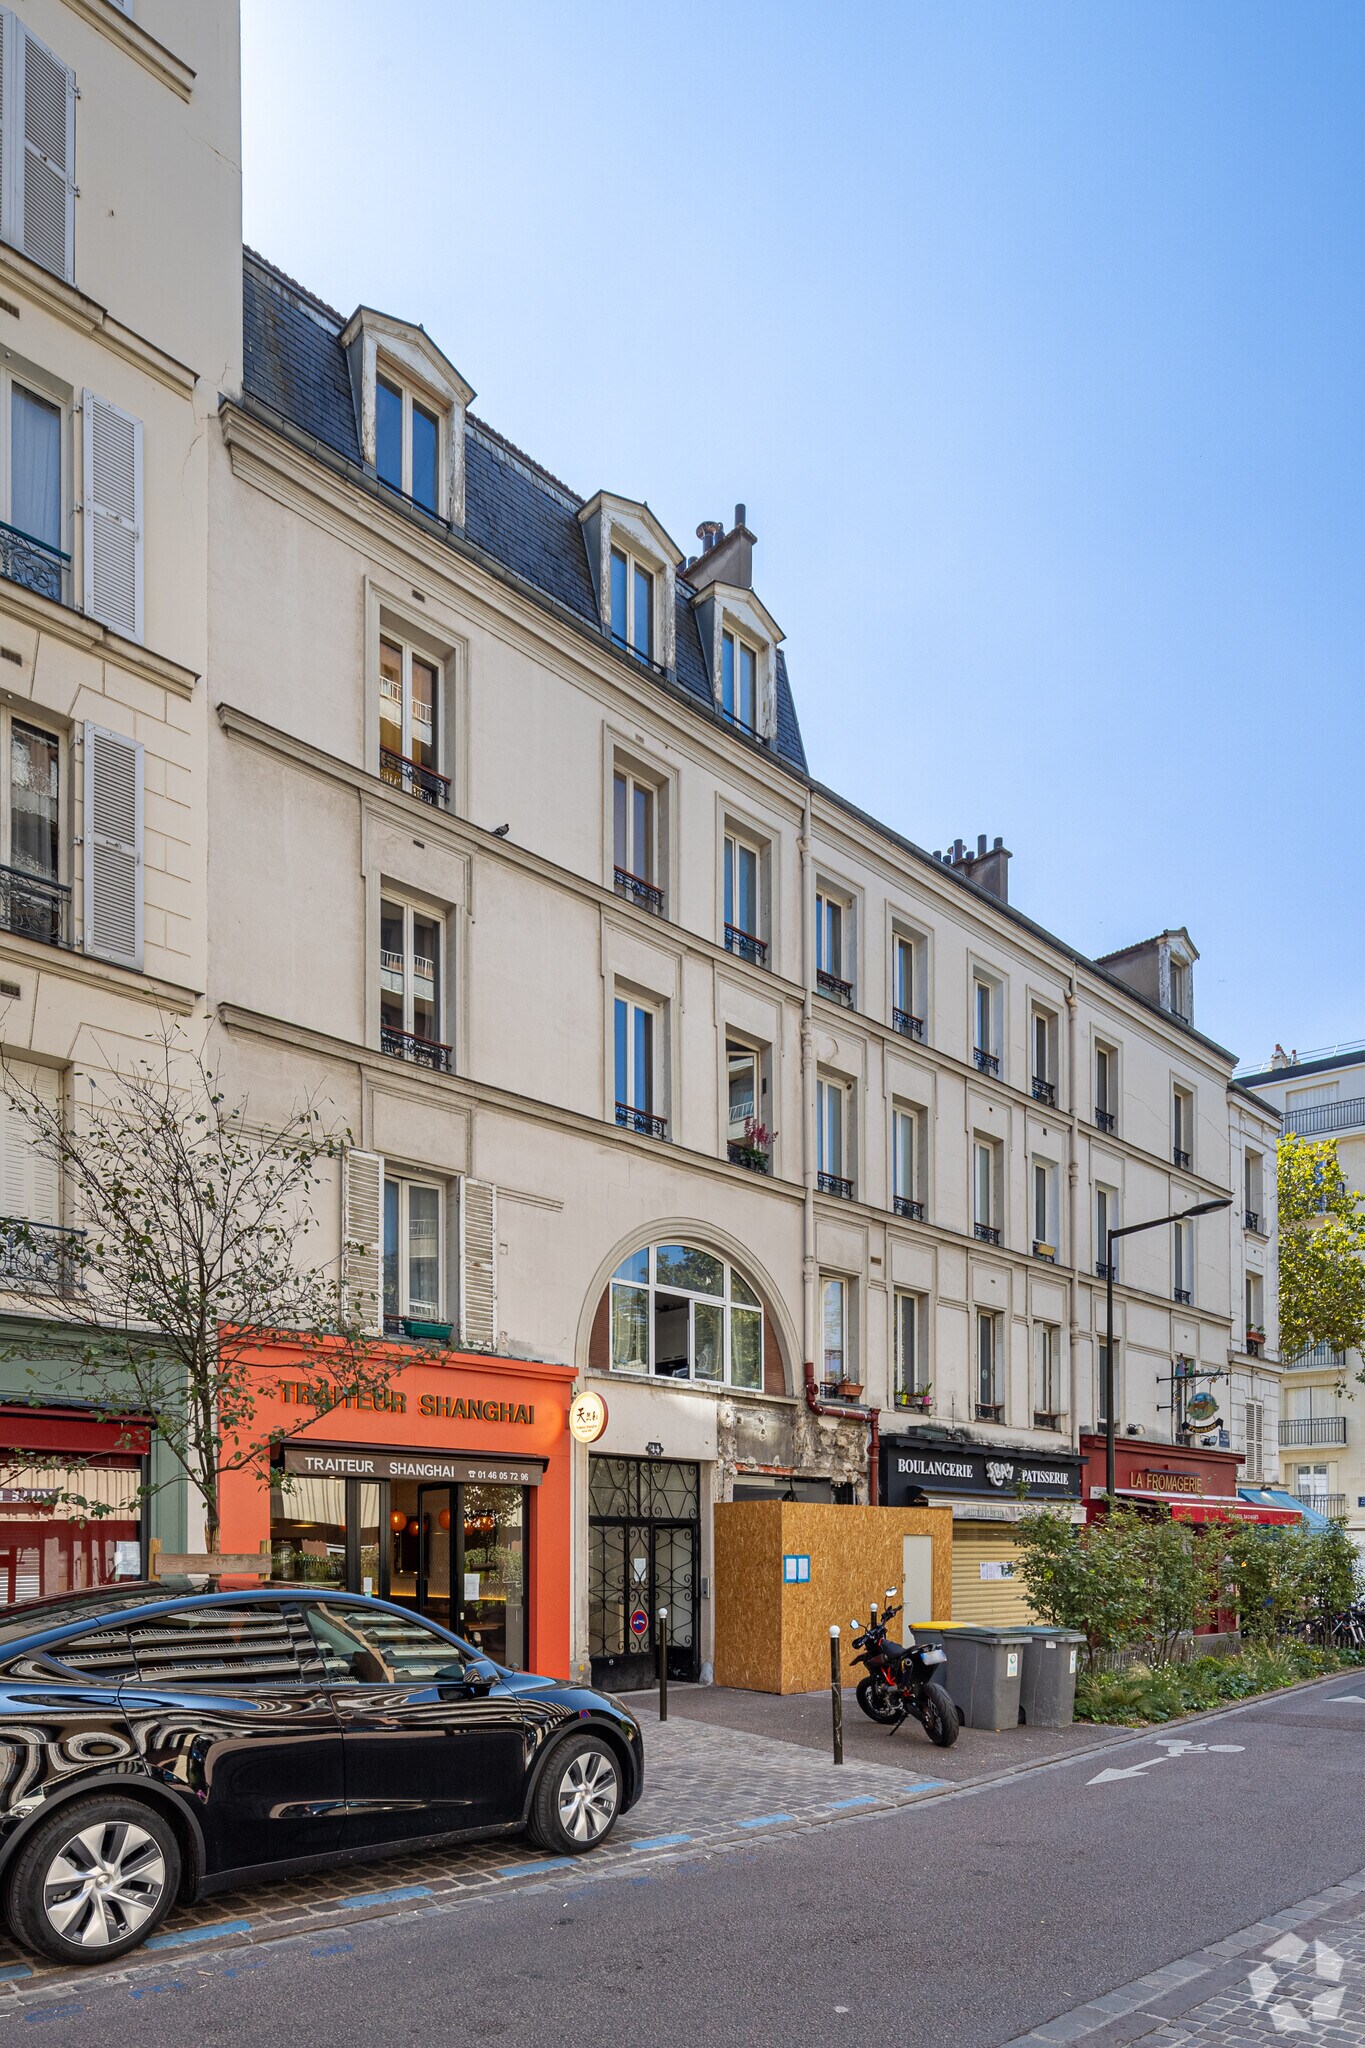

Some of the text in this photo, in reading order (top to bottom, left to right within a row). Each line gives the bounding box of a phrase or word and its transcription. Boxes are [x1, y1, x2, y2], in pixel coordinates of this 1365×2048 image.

[279, 1380, 534, 1425] TRAITEUR SHANGHAI
[304, 1457, 375, 1473] TRAITEUR
[389, 1462, 455, 1478] SHANGHAI
[477, 1470, 486, 1479] 01
[488, 1471, 498, 1480] 46
[499, 1471, 508, 1480] 05
[510, 1472, 518, 1481] 72
[898, 1458, 973, 1478] BOULANGERIE
[1022, 1469, 1069, 1485] PATISSERIE
[1130, 1471, 1203, 1493] LA FROMAGERIE
